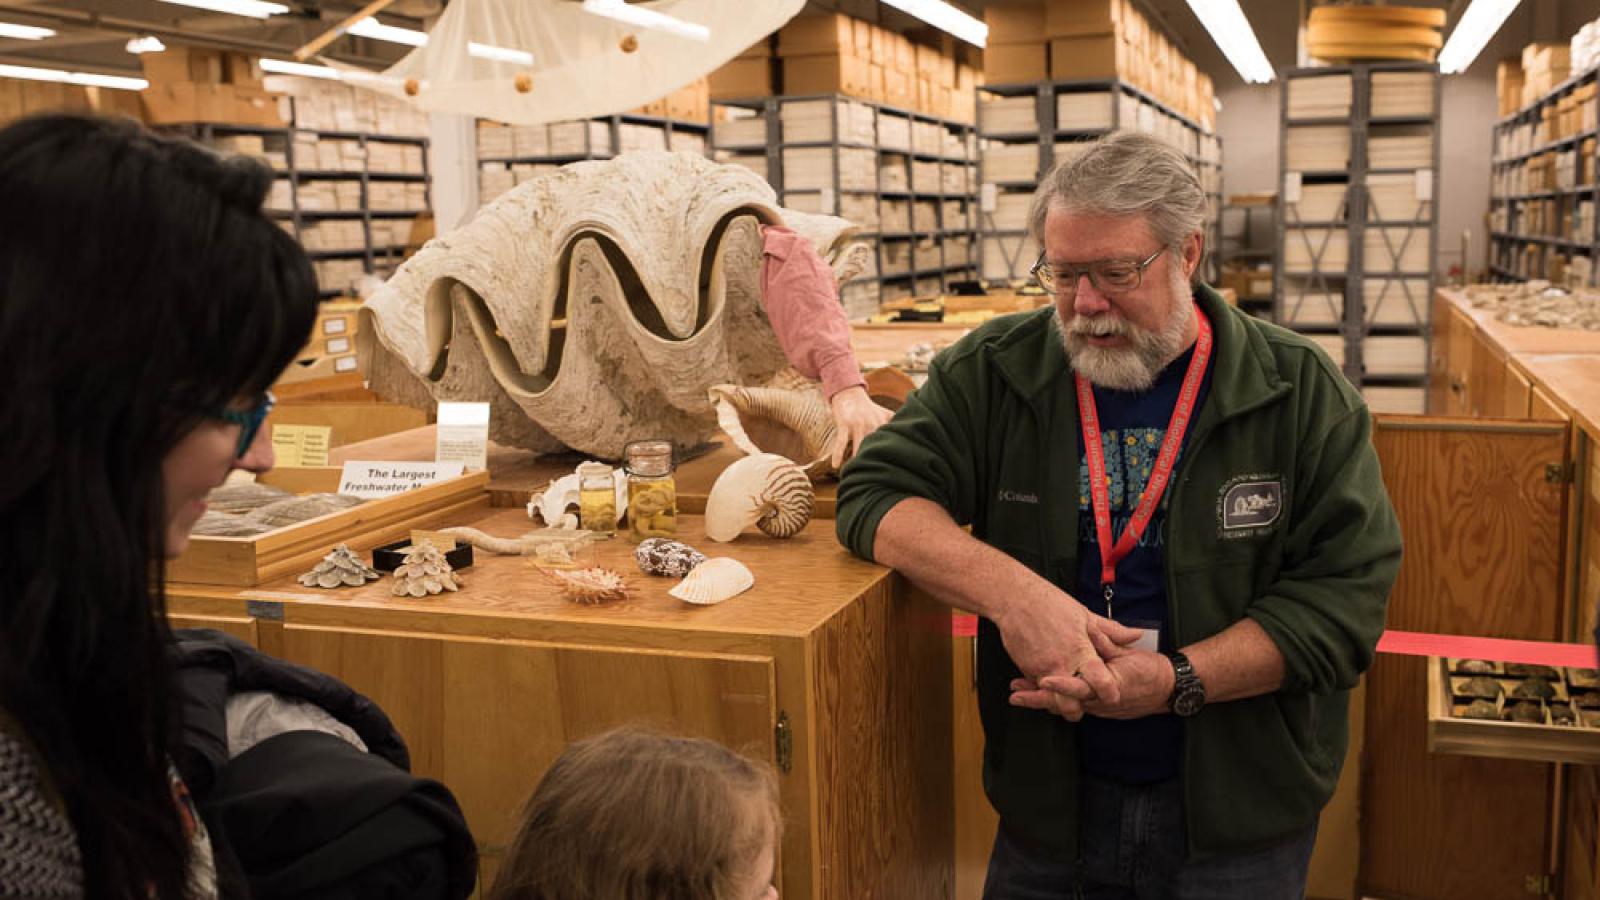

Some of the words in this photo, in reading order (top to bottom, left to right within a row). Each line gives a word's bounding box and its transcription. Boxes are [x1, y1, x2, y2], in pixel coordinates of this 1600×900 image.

[1199, 332, 1211, 351] The
[1183, 353, 1206, 401] Museum
[1178, 402, 1189, 415] of
[1087, 426, 1096, 437] of
[1159, 417, 1185, 471] Biological
[1089, 440, 1103, 486] Museum
[368, 468, 389, 478] The
[391, 468, 436, 480] Largest
[344, 482, 408, 491] Freshwater
[1095, 490, 1105, 512] The
[1136, 473, 1164, 521] Diversity
